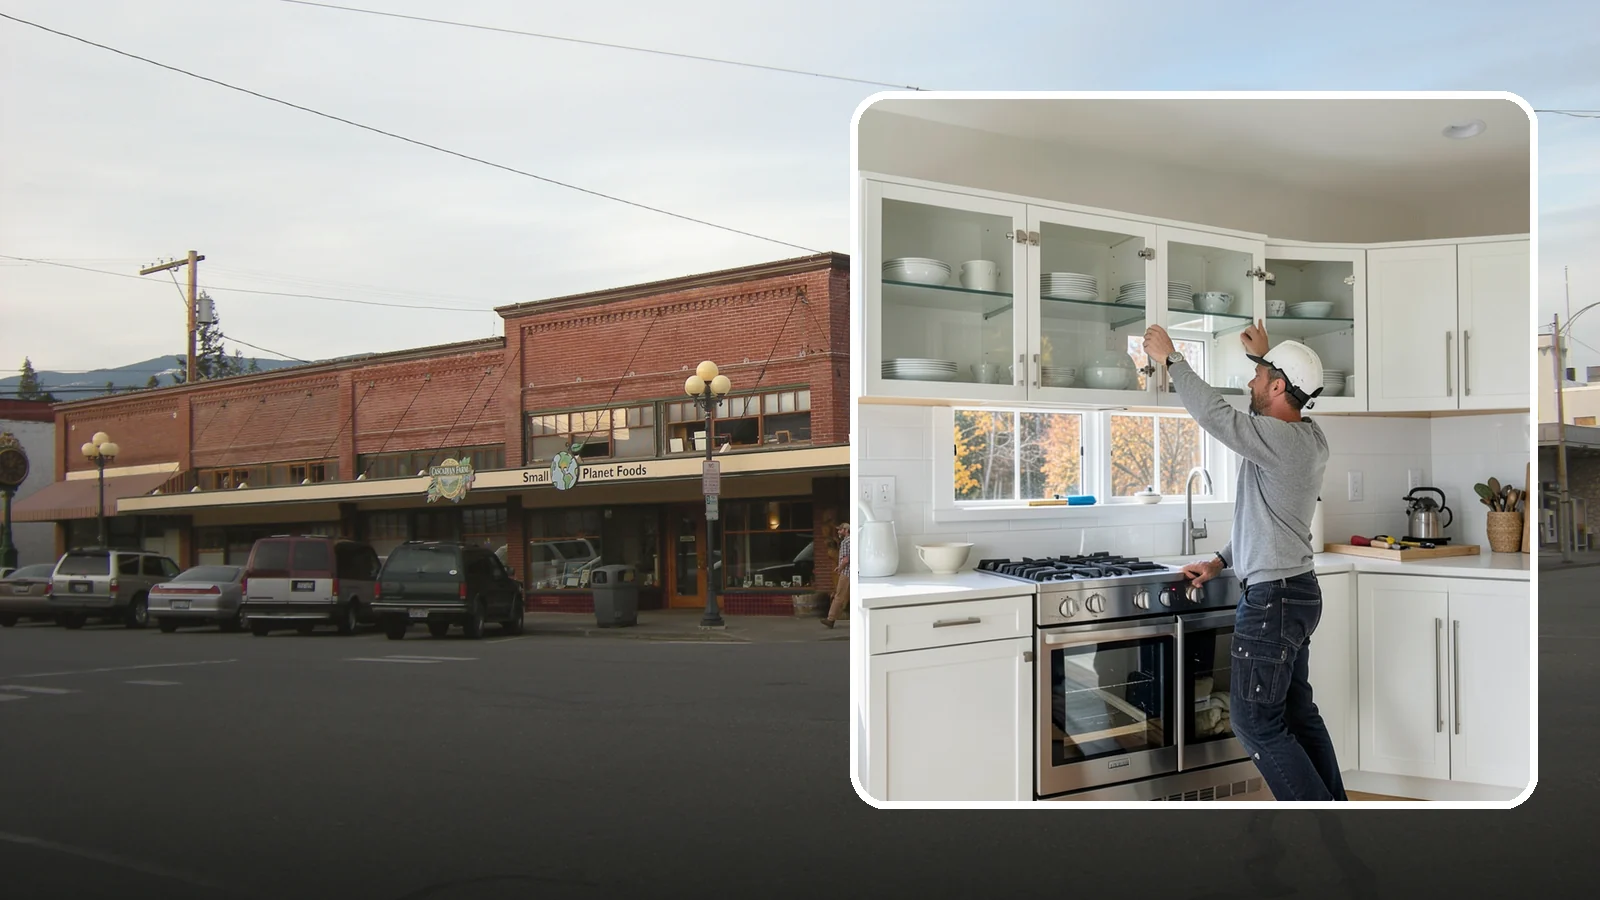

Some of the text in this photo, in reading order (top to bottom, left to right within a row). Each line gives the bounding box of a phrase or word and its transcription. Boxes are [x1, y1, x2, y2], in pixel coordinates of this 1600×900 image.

[523, 464, 647, 483] Small Planet Foods
